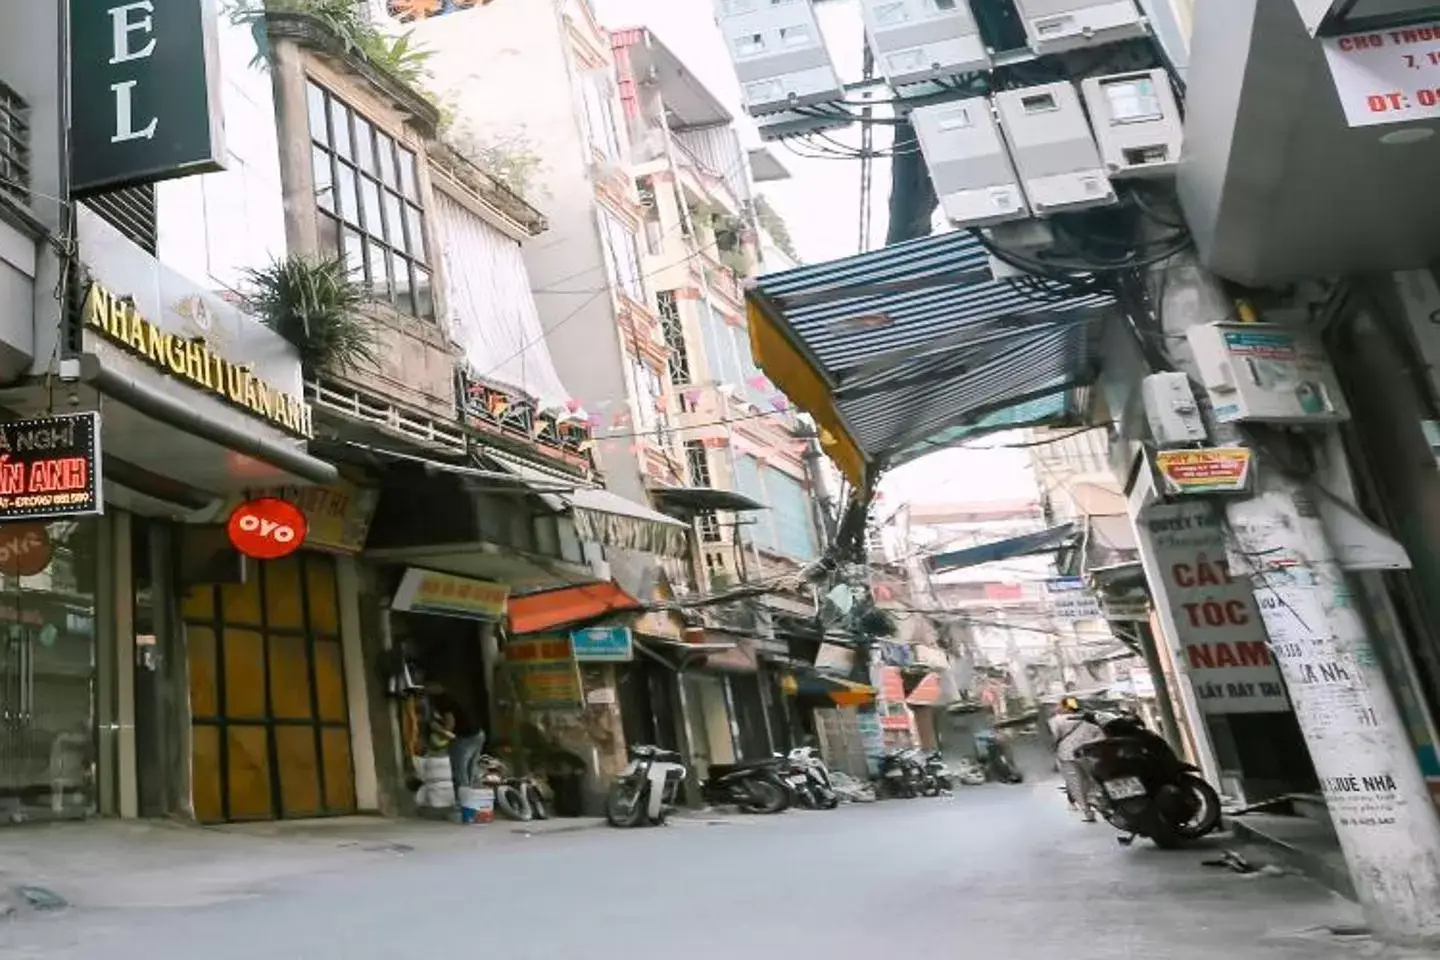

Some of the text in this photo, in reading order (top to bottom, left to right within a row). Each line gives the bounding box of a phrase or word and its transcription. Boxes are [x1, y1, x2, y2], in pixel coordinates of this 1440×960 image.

[91, 283, 147, 354] NHÀ
[273, 392, 315, 441] ANH
[29, 457, 87, 492] ANH
[239, 514, 294, 542] OYO
[1186, 641, 1273, 669] NAM
